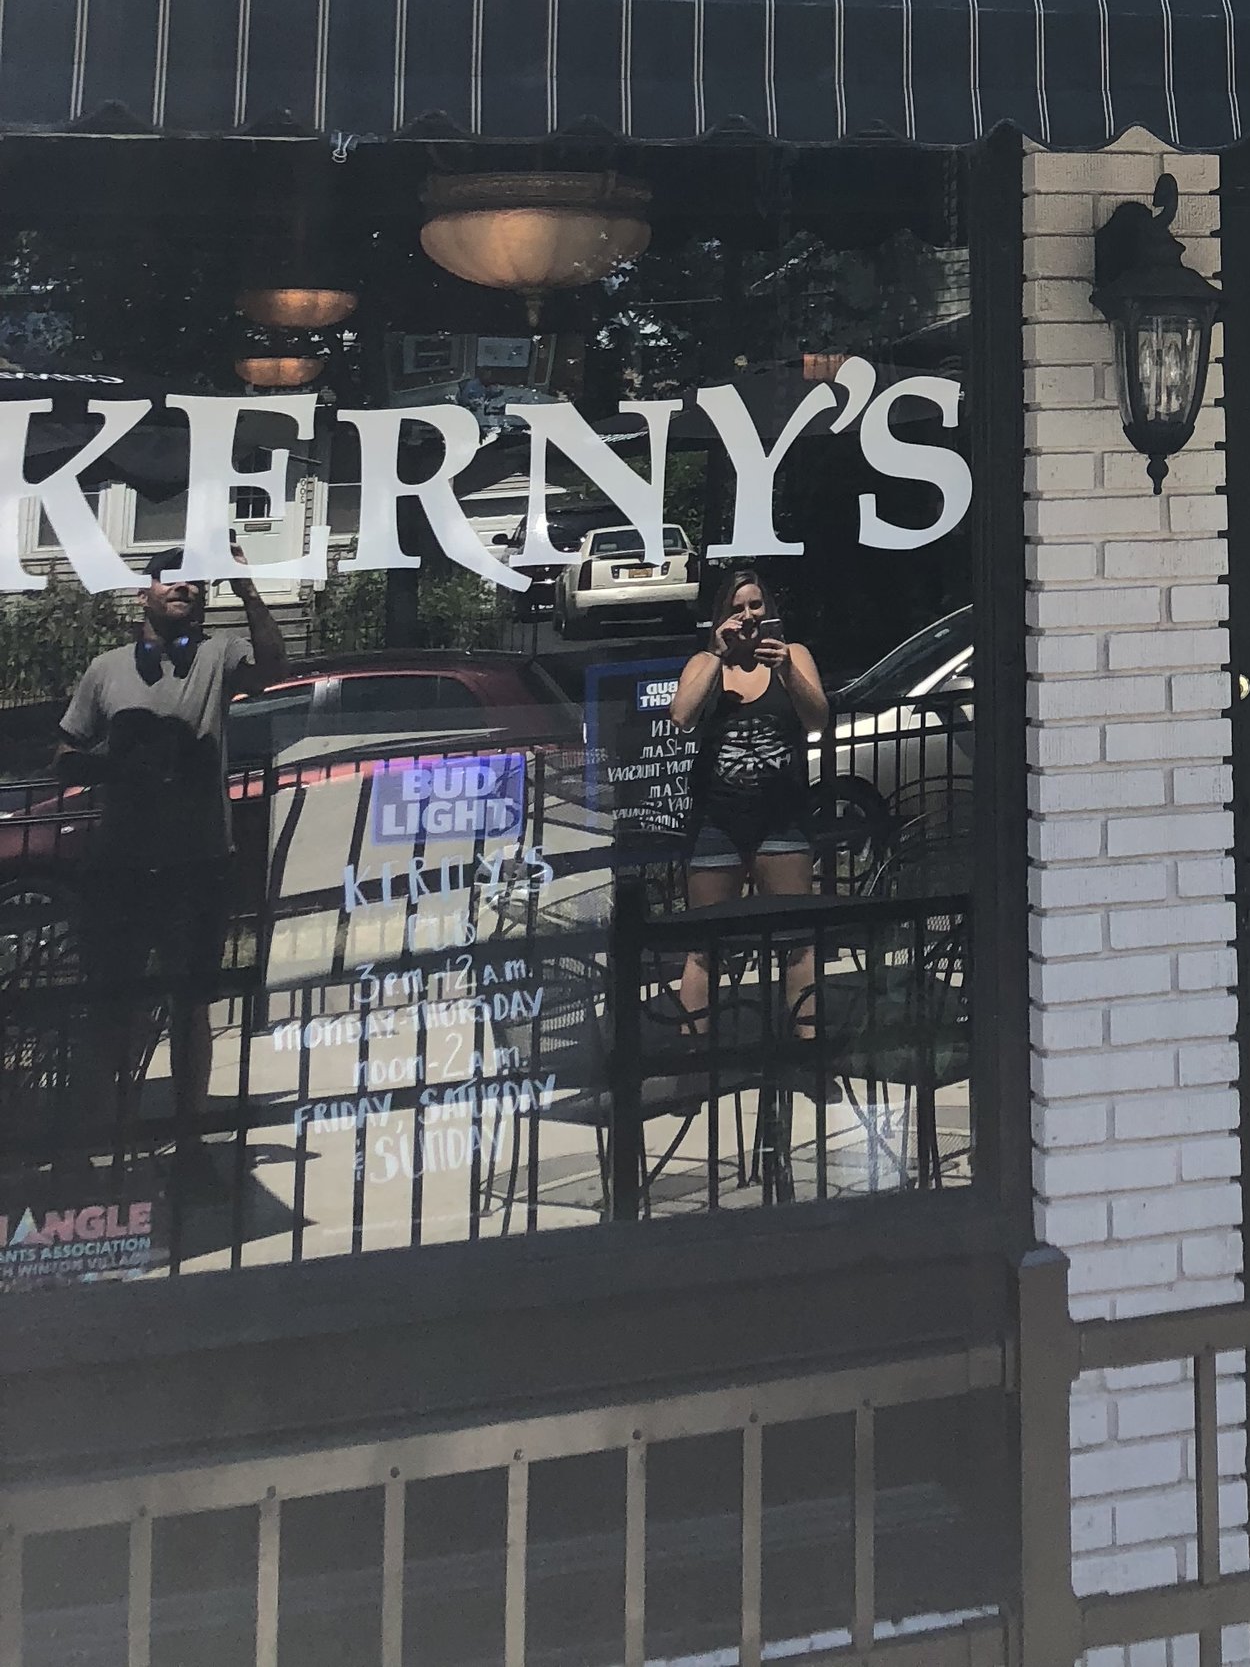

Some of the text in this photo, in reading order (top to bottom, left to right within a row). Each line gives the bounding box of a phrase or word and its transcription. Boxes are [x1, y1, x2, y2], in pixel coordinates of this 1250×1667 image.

[0, 356, 974, 594] KERNY'S
[401, 765, 498, 801] BUD
[382, 797, 514, 836] LIGHT
[418, 1073, 556, 1126] SATURDAY
[369, 1119, 506, 1184] SUNDAY
[40, 1236, 152, 1261] ASSOCIATION
